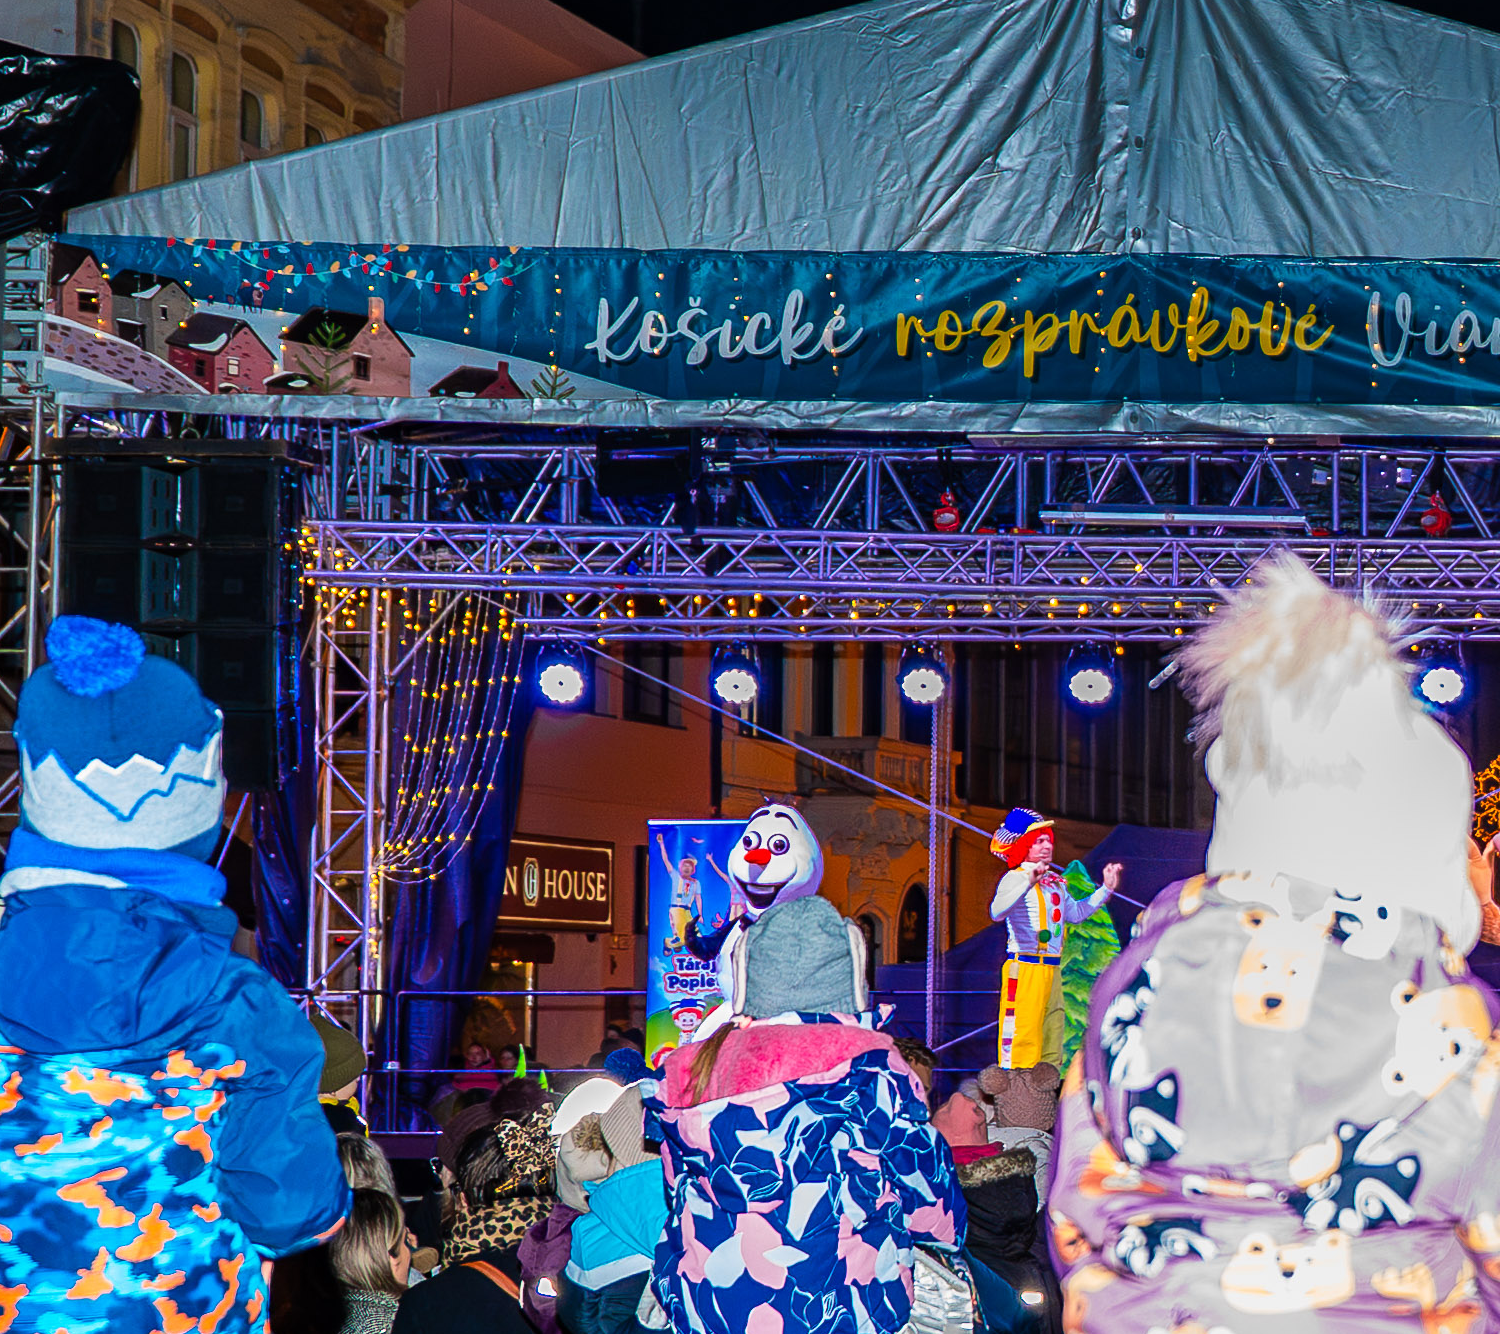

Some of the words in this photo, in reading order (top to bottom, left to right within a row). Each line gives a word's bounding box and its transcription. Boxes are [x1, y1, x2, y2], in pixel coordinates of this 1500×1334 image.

[584, 288, 864, 366] Košické
[896, 286, 1336, 378] rozprávkové
[543, 867, 607, 902] HOUSE
[674, 956, 717, 974] Táraj
